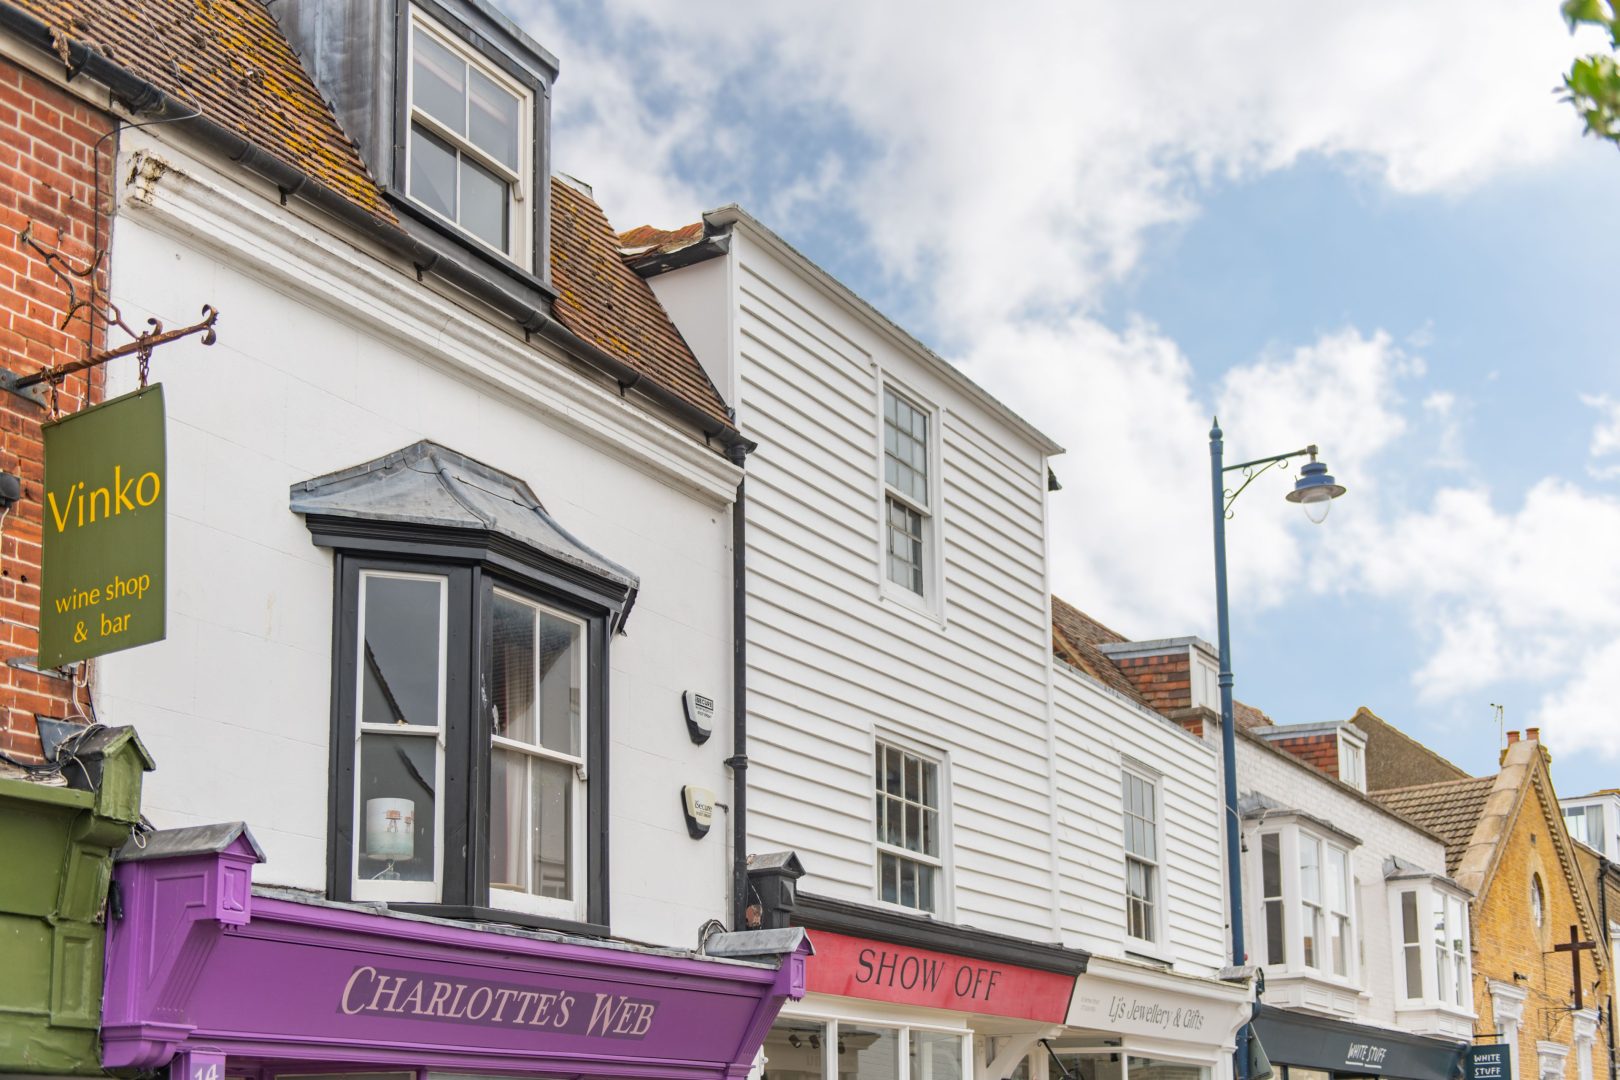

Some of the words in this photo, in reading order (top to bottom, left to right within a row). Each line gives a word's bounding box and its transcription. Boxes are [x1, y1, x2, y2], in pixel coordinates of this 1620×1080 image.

[48, 465, 161, 532] Vinko
[55, 588, 100, 613] wine
[106, 573, 150, 601] shop
[73, 620, 88, 643] &
[101, 612, 132, 636] bar
[855, 947, 945, 993] SHOW
[955, 965, 1001, 1001] OFF
[1127, 999, 1170, 1029] Jewellery
[1172, 1008, 1181, 1028] &
[1183, 1009, 1205, 1030] Gifts
[1347, 1042, 1369, 1061] WHITE
[1366, 1045, 1387, 1063] STUFF
[1473, 1053, 1501, 1063] WHITE
[1474, 1067, 1501, 1076] STUFF
